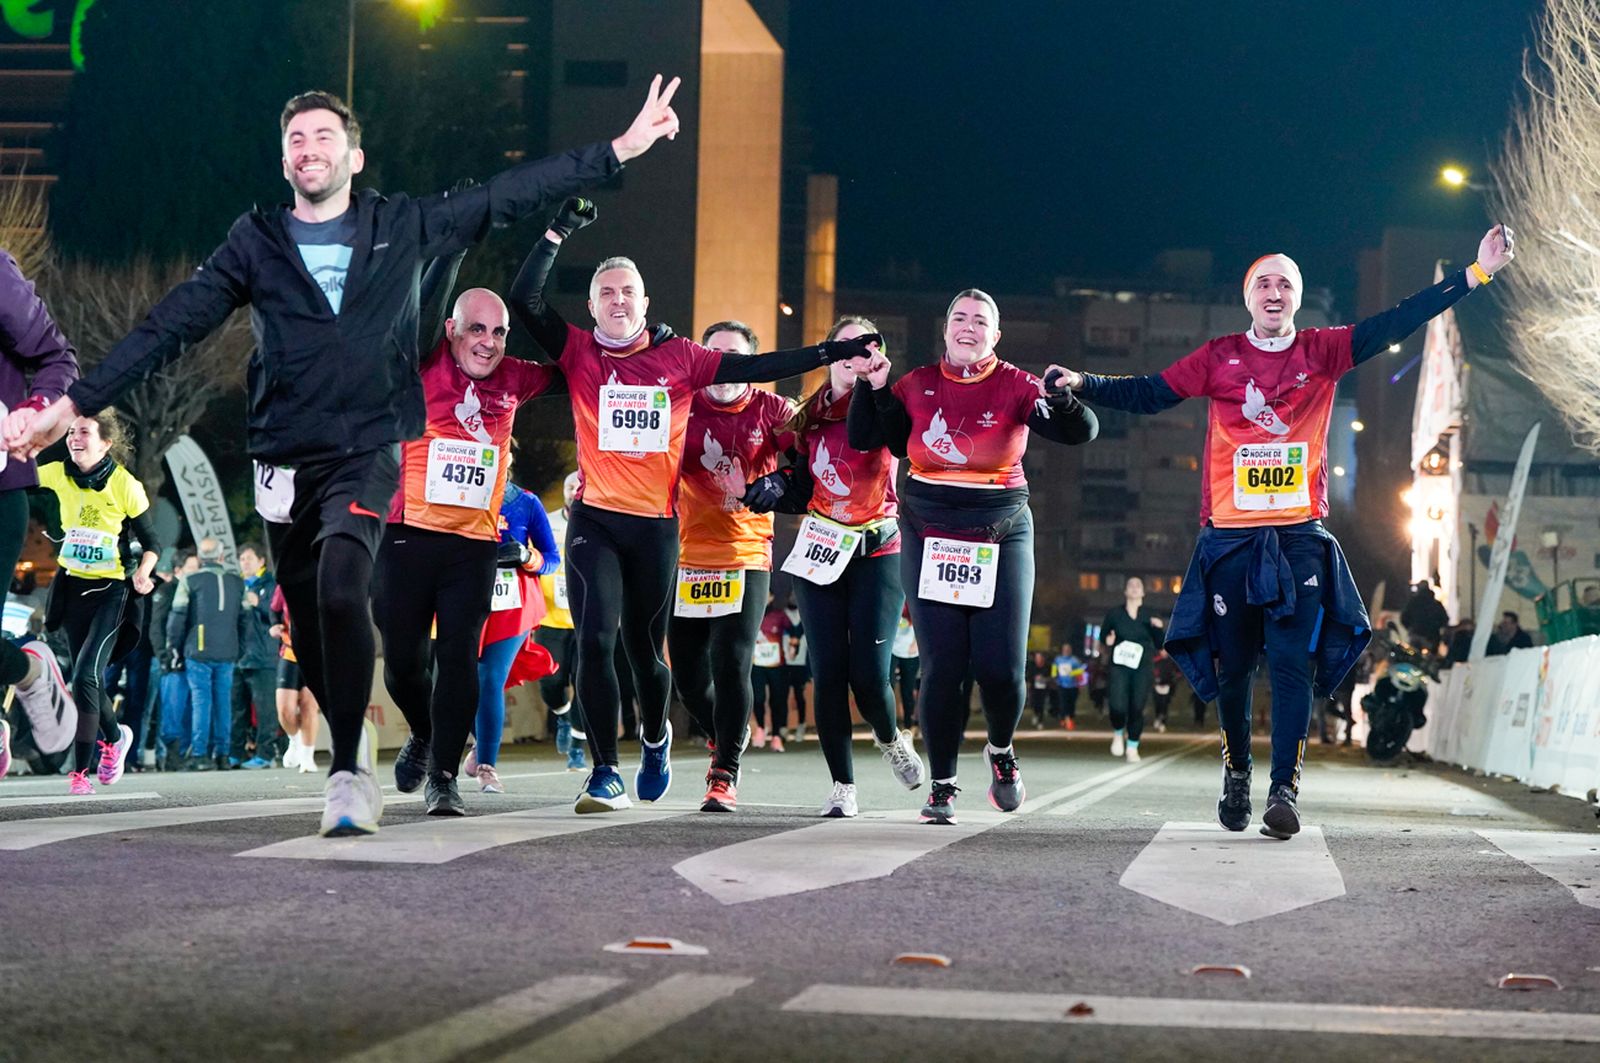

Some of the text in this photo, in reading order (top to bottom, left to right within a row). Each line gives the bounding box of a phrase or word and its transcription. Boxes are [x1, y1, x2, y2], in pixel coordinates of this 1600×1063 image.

[464, 415, 482, 432] 43
[612, 409, 661, 430] 6998
[1255, 411, 1274, 427] 43
[446, 446, 476, 456] NOCHE DE
[932, 438, 951, 455] 43
[436, 453, 451, 462] SAN
[441, 463, 486, 487] 4375
[714, 461, 731, 475] 43
[821, 469, 836, 487] 43
[1248, 466, 1295, 488] 6402
[72, 544, 103, 561] 7875
[805, 542, 840, 566] 1694
[940, 546, 971, 555] NOCHE DE
[937, 562, 982, 585] 1693
[691, 581, 730, 599] 6401
